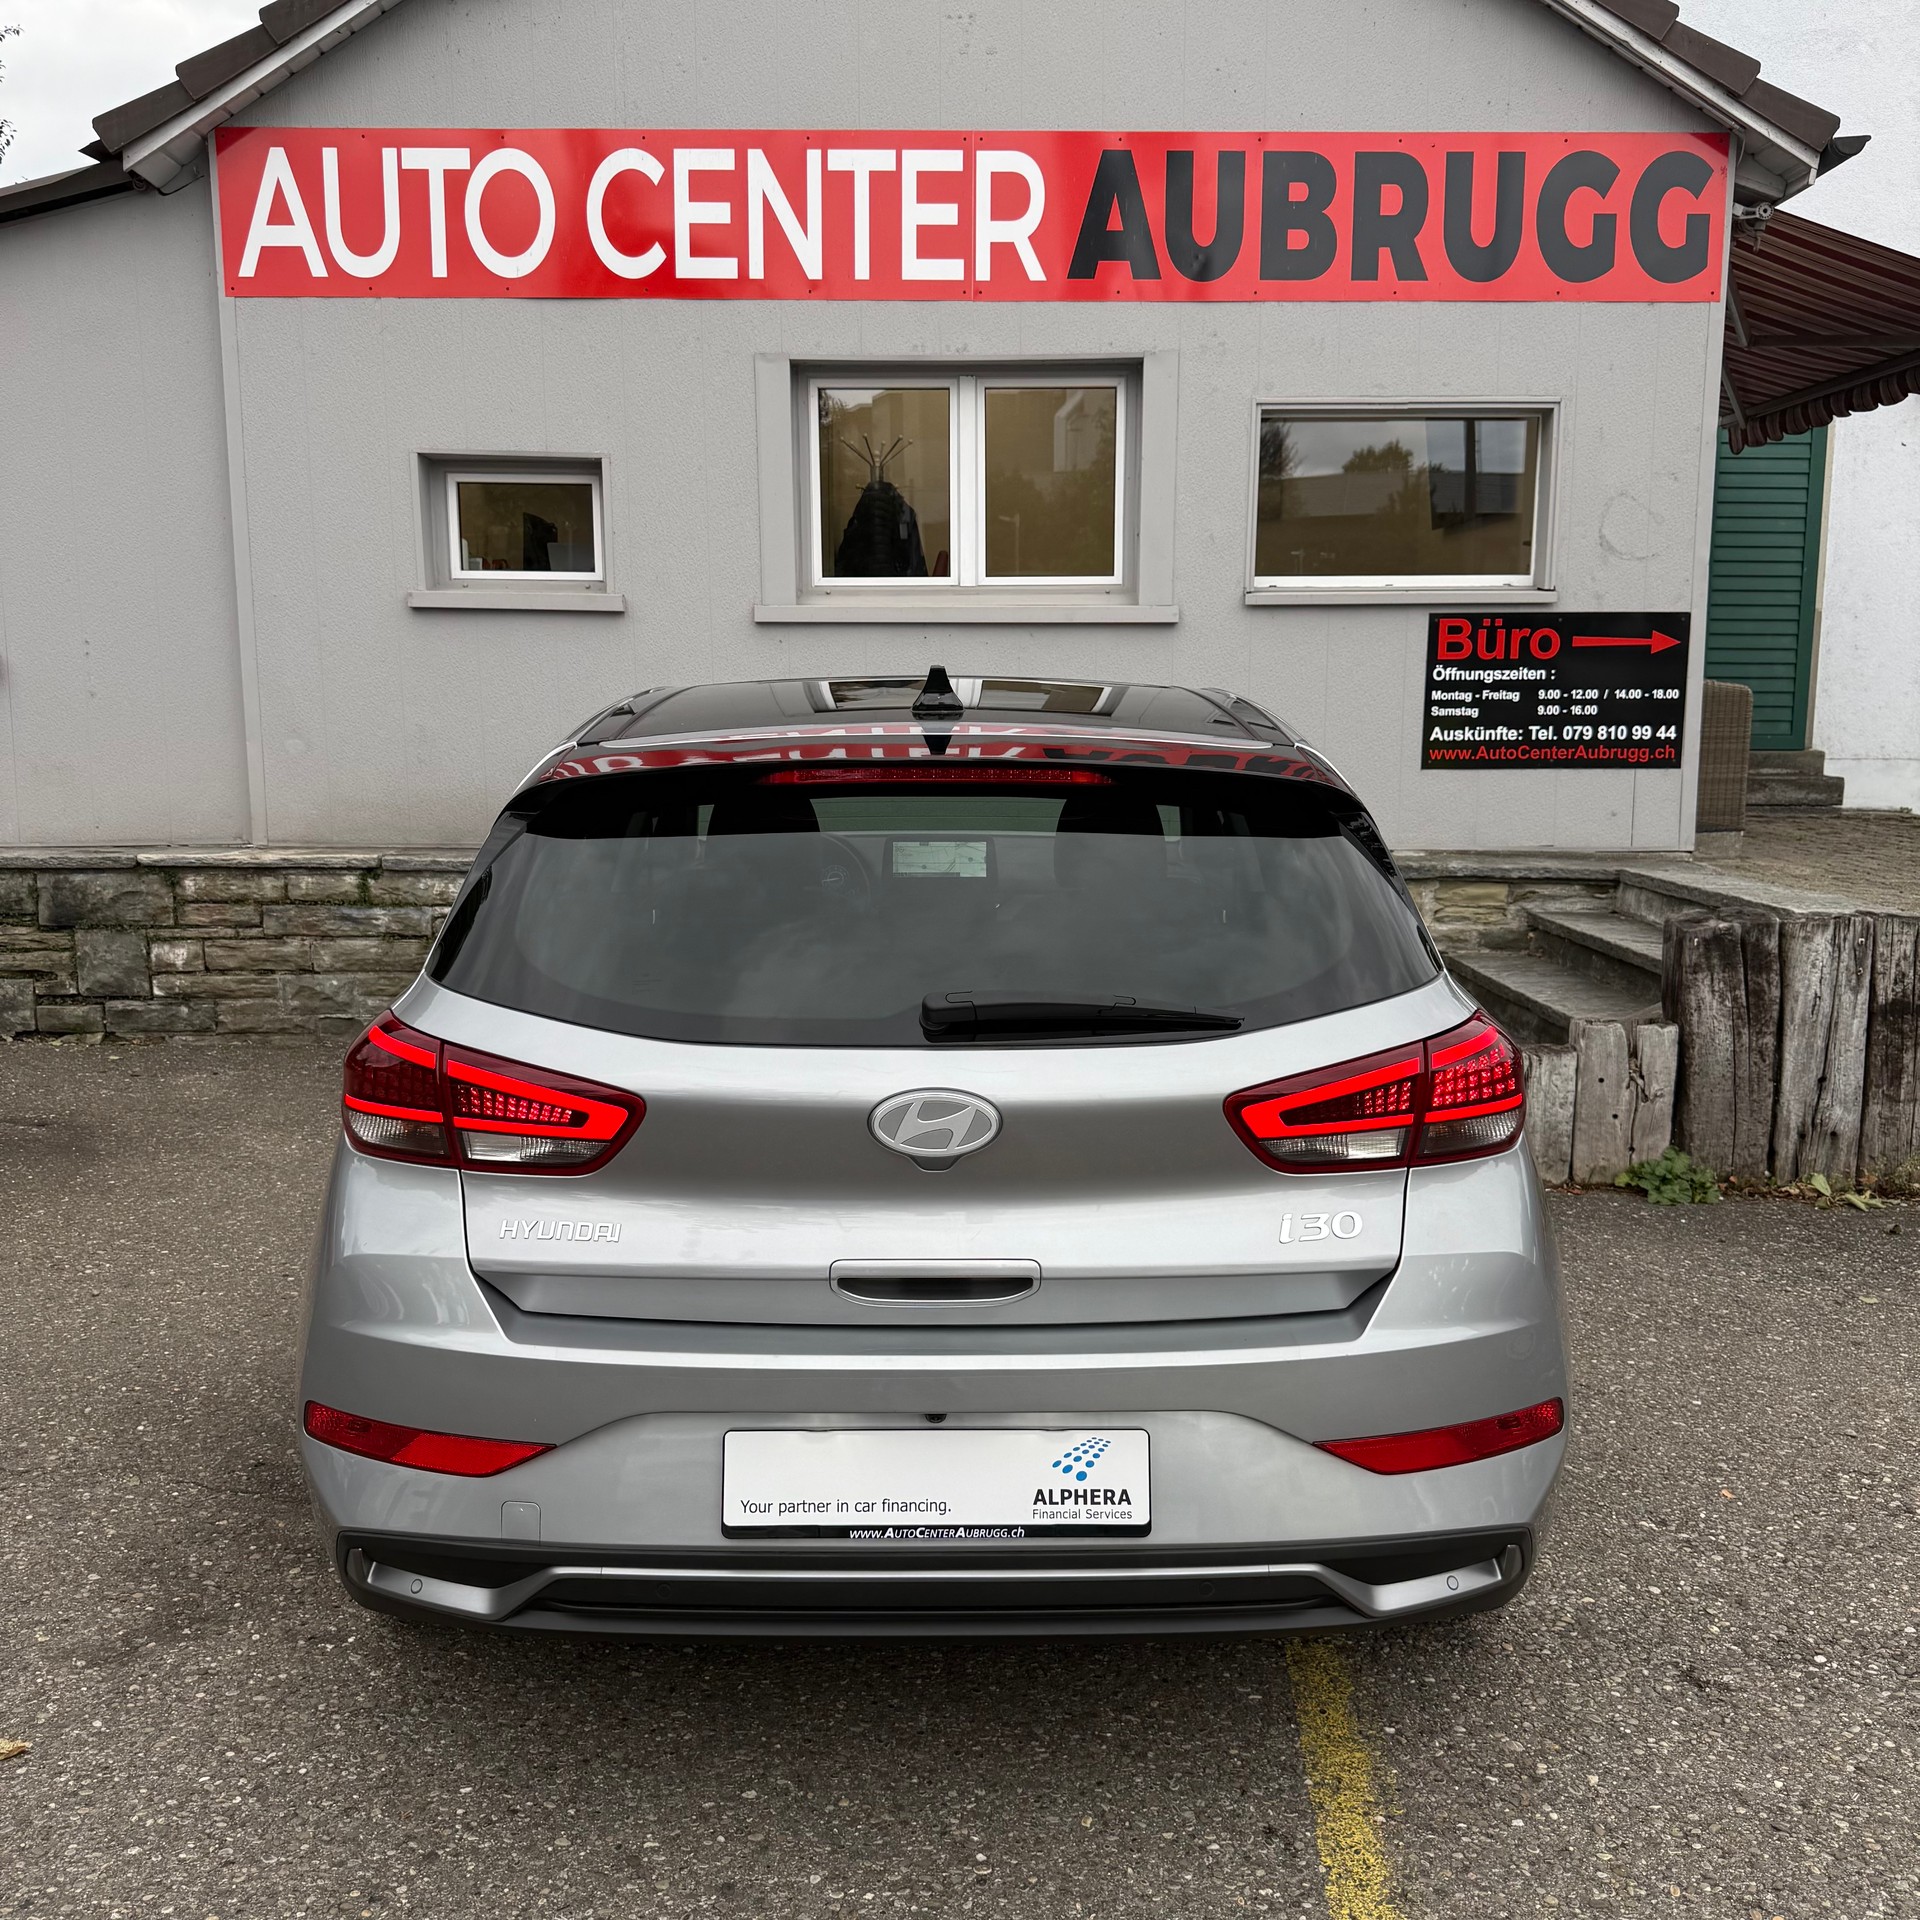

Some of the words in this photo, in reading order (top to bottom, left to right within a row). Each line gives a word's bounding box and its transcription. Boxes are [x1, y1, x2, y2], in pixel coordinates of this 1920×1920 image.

[237, 146, 556, 280] AUTO
[586, 147, 1047, 282] CENTER
[1066, 149, 1715, 284] AUBRUGG
[1437, 618, 1561, 660] Büro
[1432, 664, 1547, 683] Öffnungszeiten
[1431, 690, 1473, 702] Montag
[1482, 689, 1520, 702] Freitag
[1538, 689, 1561, 700] 9.00
[1571, 689, 1599, 700] 12.00
[1614, 689, 1642, 699] 14.00
[1652, 689, 1680, 699] 18.00
[1430, 706, 1479, 718] Samstag
[1537, 705, 1560, 716] 9.00
[1570, 705, 1598, 716] 16.00
[1429, 725, 1524, 742] Auskünfte:
[1528, 726, 1558, 741] Tel.
[1562, 725, 1593, 741] 079
[1597, 725, 1627, 740] 810
[1631, 725, 1652, 740] 99
[1655, 725, 1677, 740] 44
[1429, 745, 1676, 763] www.AutoCenterAubrugg.ch
[499, 1219, 622, 1243] HYUNDAI
[1278, 1210, 1363, 1244] i30
[1033, 1488, 1132, 1506] ALPHERA
[740, 1499, 774, 1514] Your
[778, 1500, 831, 1517] partner
[836, 1499, 850, 1514] in
[854, 1502, 877, 1514] car
[881, 1498, 952, 1518] financing.
[1032, 1508, 1081, 1521] Financial
[1085, 1508, 1133, 1521] Services
